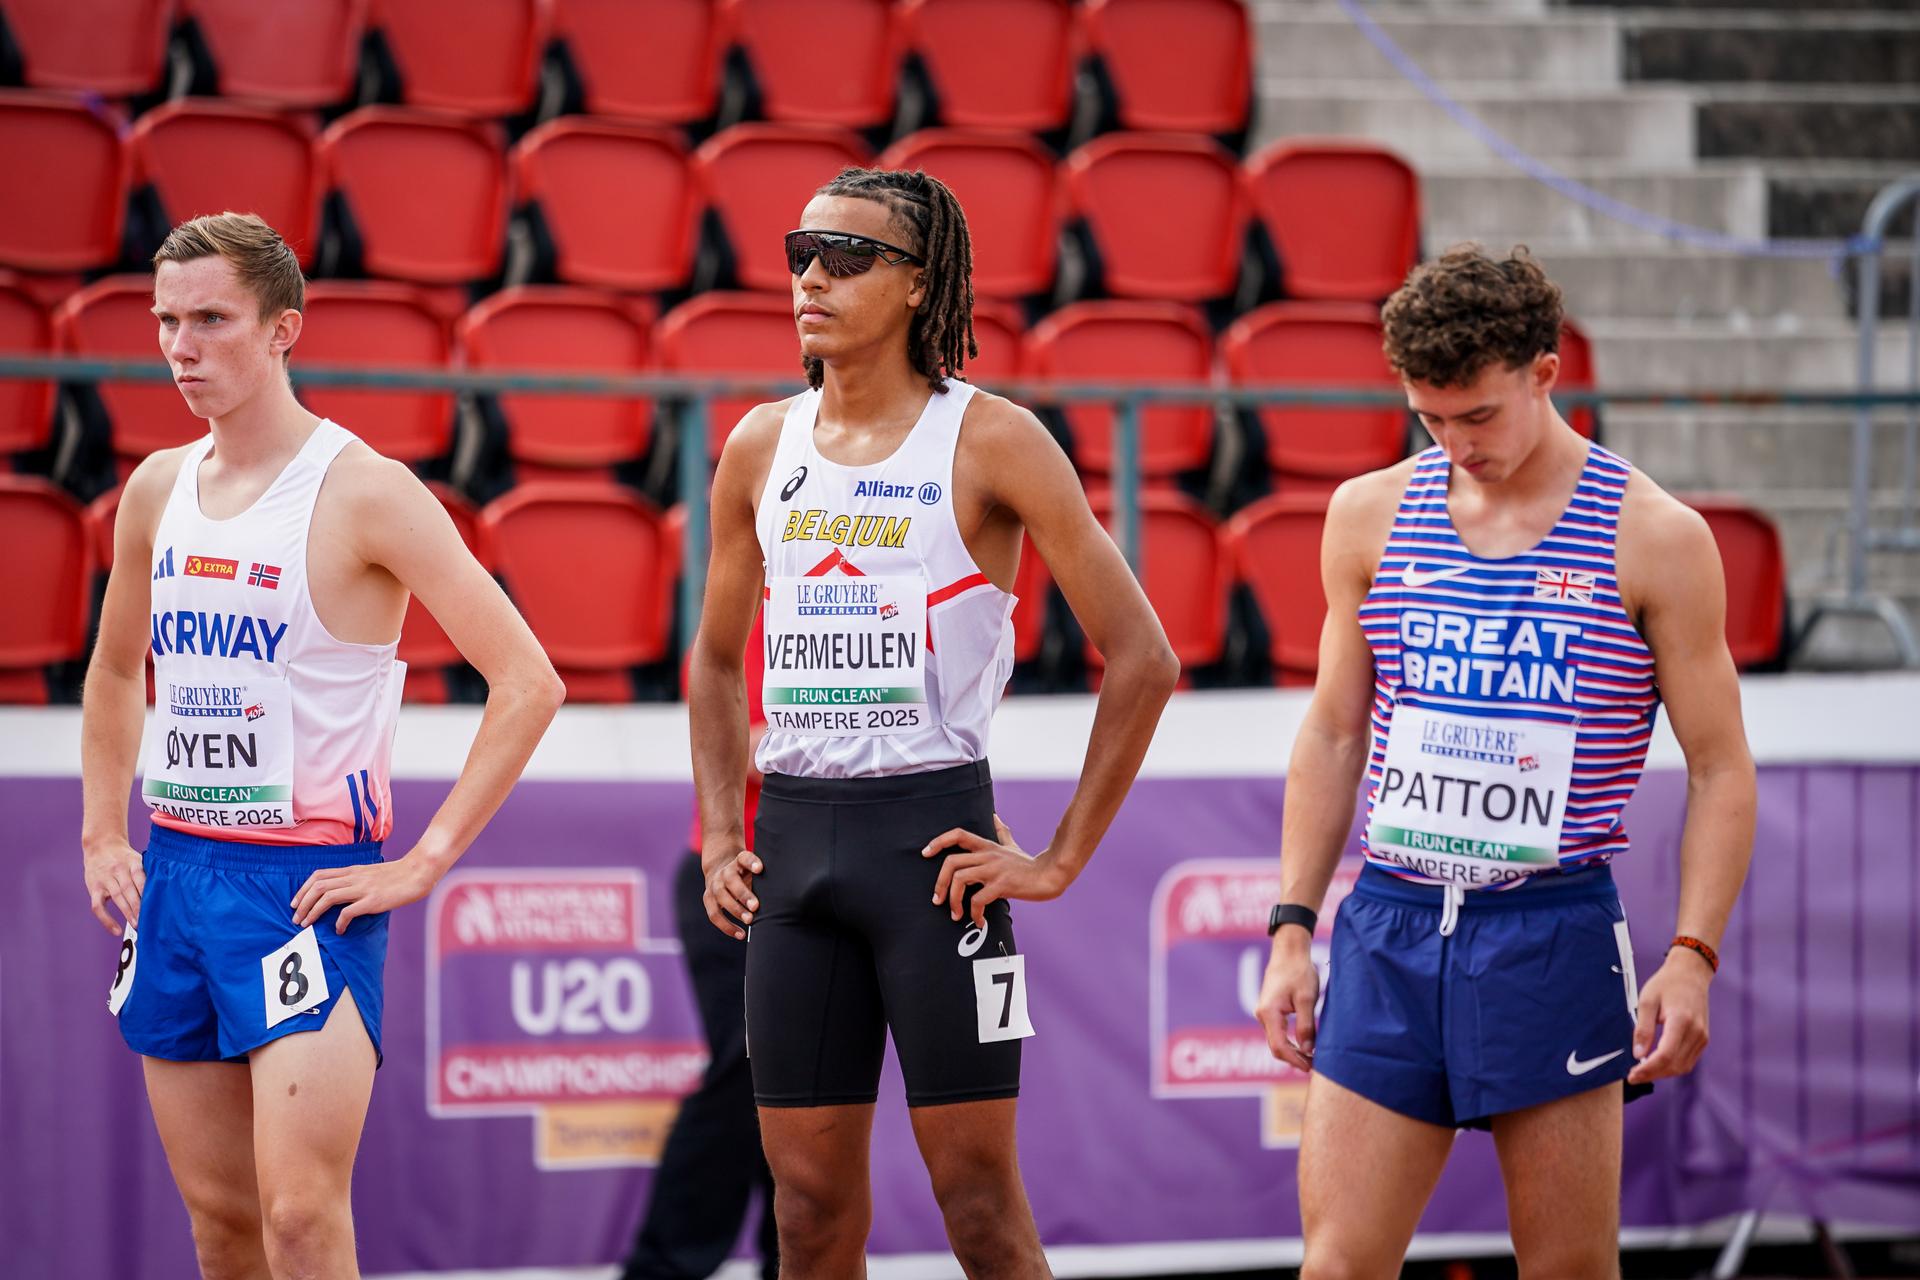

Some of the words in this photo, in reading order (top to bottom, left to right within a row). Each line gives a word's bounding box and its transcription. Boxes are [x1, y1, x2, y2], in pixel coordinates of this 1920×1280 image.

[854, 480, 914, 498] Allianz
[782, 509, 911, 548] BELGIUM
[204, 562, 233, 575] EXTRA
[797, 584, 811, 604] LE
[800, 606, 874, 615] SWITZERLAND
[1400, 610, 1582, 660] GREAT
[767, 632, 916, 670] VERMEULEN
[1402, 651, 1577, 703] BRITAIN
[169, 683, 177, 703] LE
[792, 689, 797, 703] I
[799, 689, 829, 703] RUN
[171, 705, 239, 717] SWITZERLAND
[771, 711, 860, 730] TAMPERE
[867, 709, 920, 729] 2025
[1422, 719, 1438, 741] LE
[166, 726, 258, 770] ØYEN
[166, 785, 171, 797] I
[171, 785, 199, 800] RUN
[1379, 767, 1554, 827] PATTON
[235, 808, 284, 825] 2025
[1403, 830, 1409, 846] I
[1411, 831, 1448, 852] RUN
[279, 951, 309, 1006] 8
[510, 957, 651, 1035] U20
[991, 971, 1015, 1029] 7
